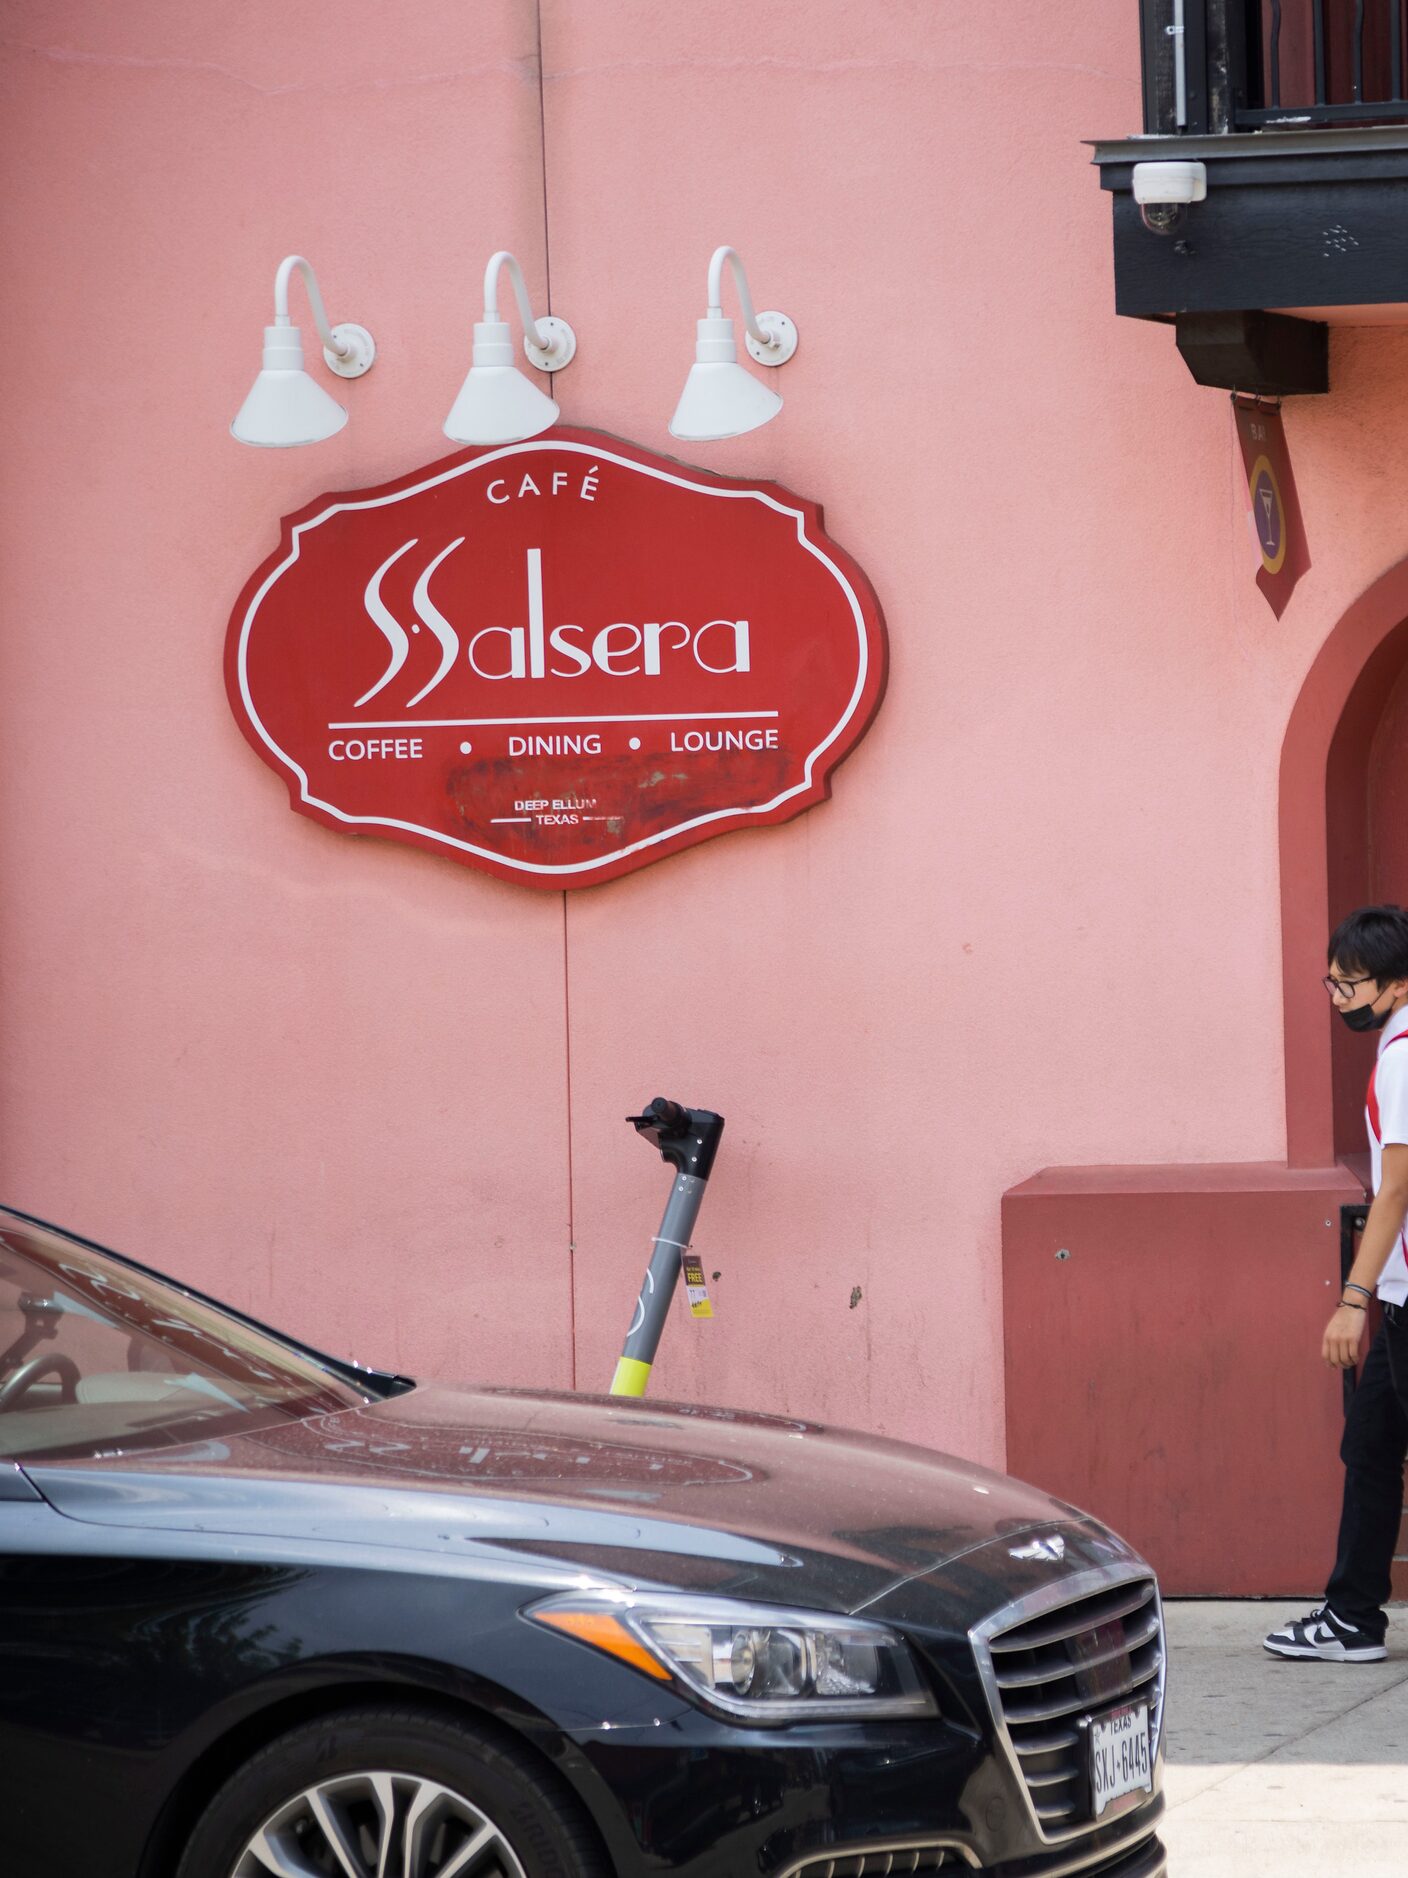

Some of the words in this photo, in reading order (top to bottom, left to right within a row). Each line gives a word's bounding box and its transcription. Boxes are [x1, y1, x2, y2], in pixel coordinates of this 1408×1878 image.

[486, 465, 599, 504] CAFÉ
[328, 738, 423, 760] COFFEE
[509, 734, 601, 757] DINING
[670, 729, 779, 753] LOUNGE
[514, 800, 549, 811] DEEP
[535, 814, 579, 825] TEXAS
[687, 1272, 705, 1283] FREE
[1110, 1714, 1132, 1736] TEXAS
